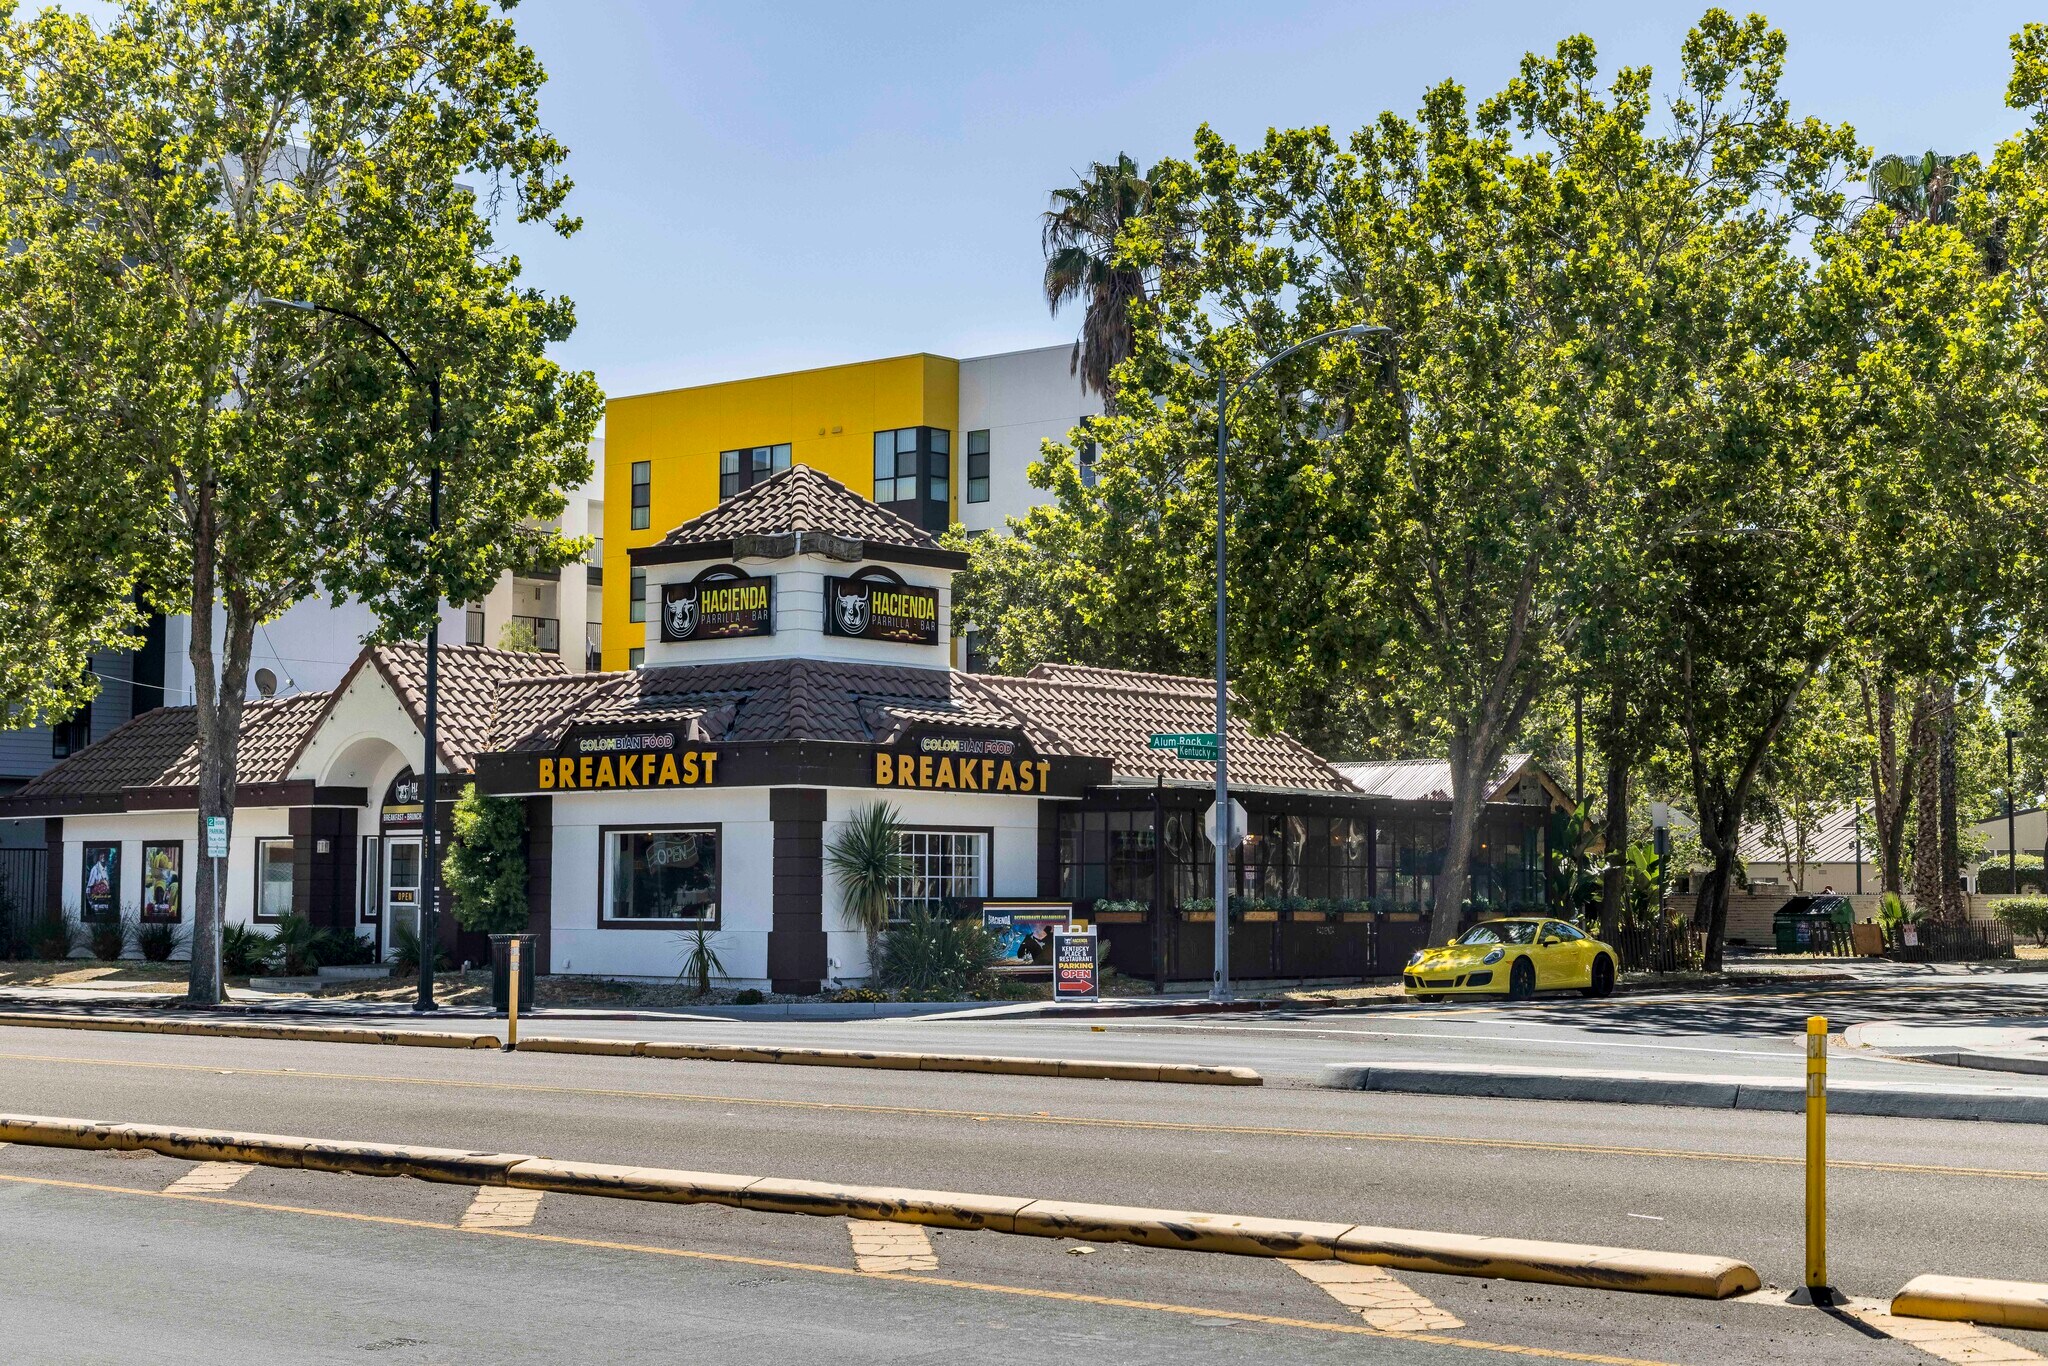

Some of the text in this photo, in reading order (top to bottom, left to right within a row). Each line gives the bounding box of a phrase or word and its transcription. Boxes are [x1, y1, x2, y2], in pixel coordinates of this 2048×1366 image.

[701, 585, 767, 614] HACIENDA
[872, 591, 935, 620] HACIENDA
[701, 609, 768, 625] PARRILLA BAR
[872, 614, 936, 631] PARRILLA BAR
[579, 734, 674, 752] COLOMBIAN FOOD
[923, 738, 1014, 755] COLOMBIAN FOOD
[1153, 736, 1177, 747] Alum
[1179, 736, 1202, 746] Rock
[1179, 745, 1211, 759] Kentucky
[539, 751, 717, 789] BREAKFAST
[876, 752, 1050, 793] BREAKFAST
[208, 818, 214, 826] 2
[383, 813, 422, 822] BREAKFAST BRUNCH
[657, 844, 688, 865] OPEN
[397, 892, 413, 901] OPEN
[1061, 970, 1092, 979] OPEN
